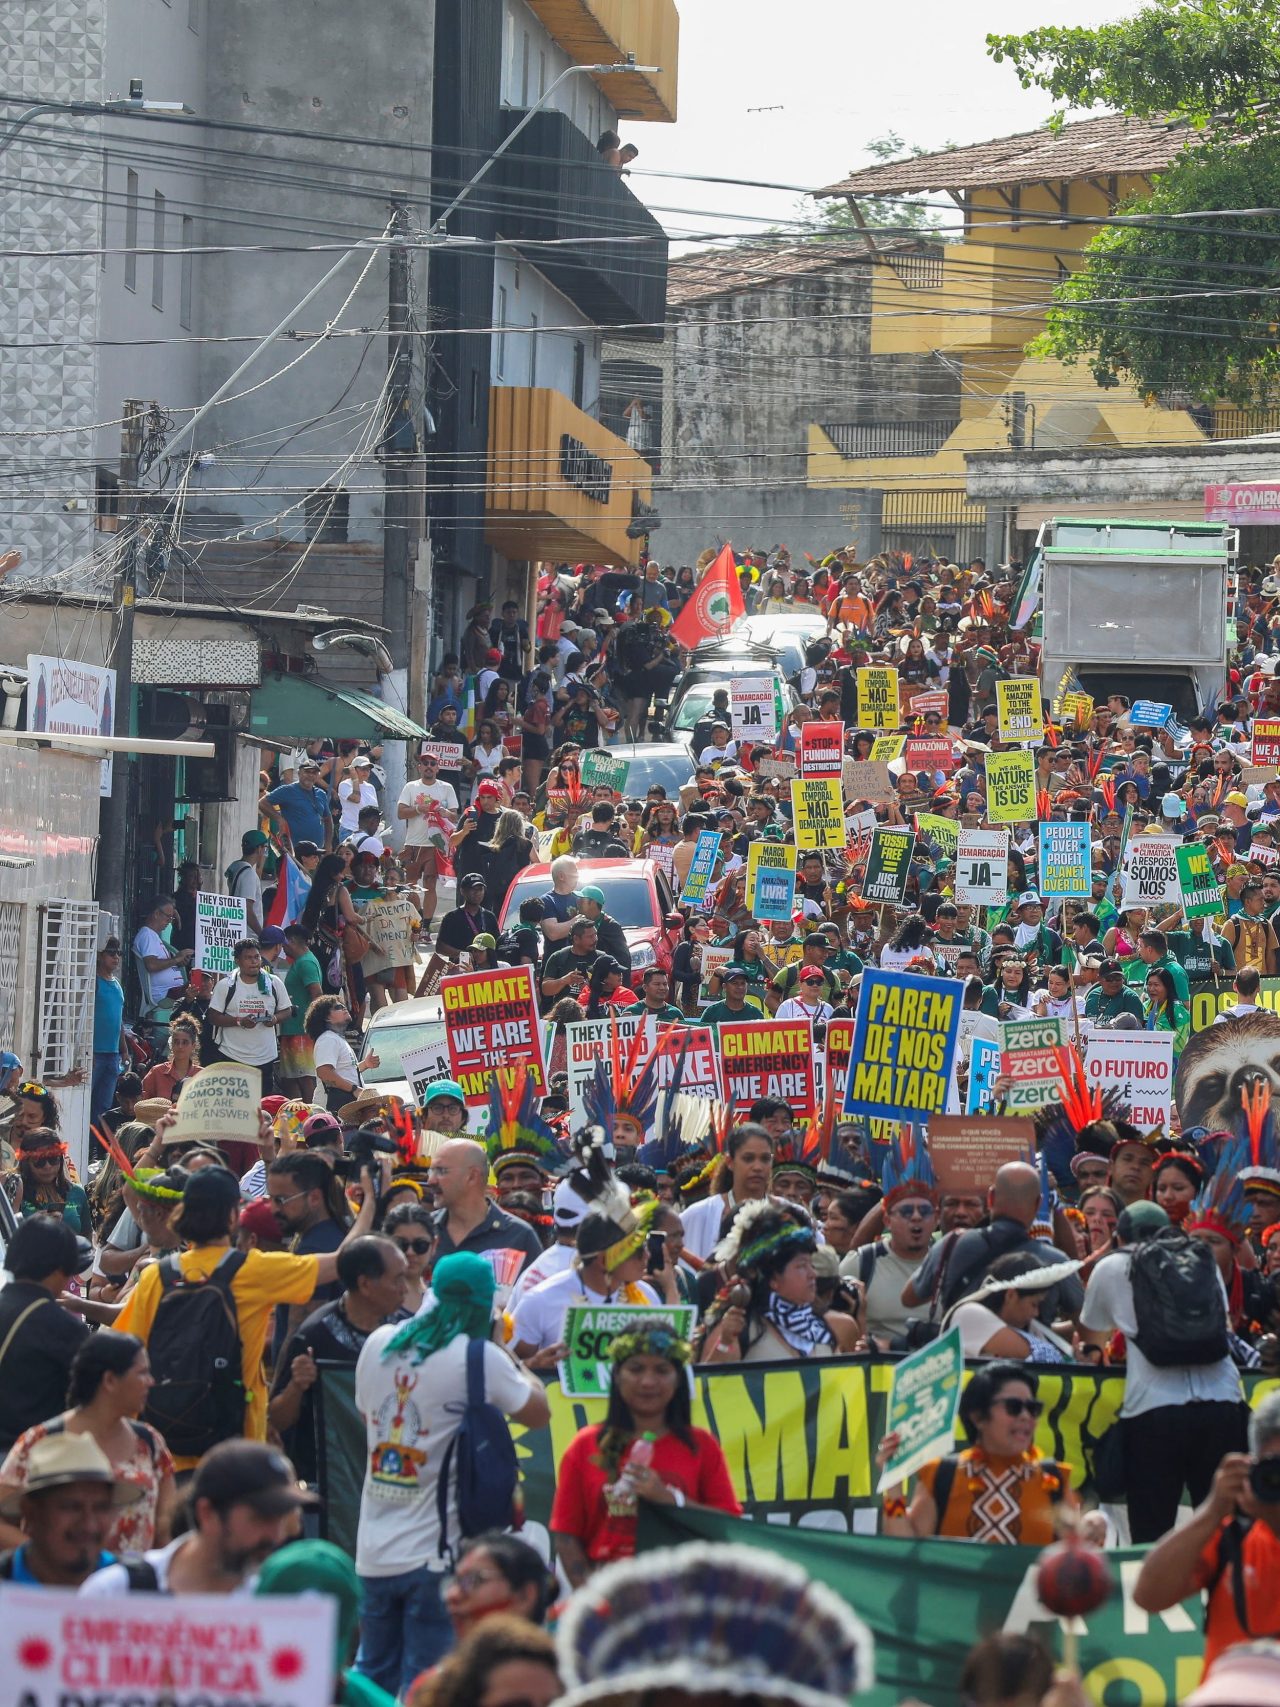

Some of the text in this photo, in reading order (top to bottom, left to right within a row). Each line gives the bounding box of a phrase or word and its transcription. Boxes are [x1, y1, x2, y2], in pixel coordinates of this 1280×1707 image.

[868, 670, 888, 679] MARCO
[864, 680, 892, 688] TEMPORAL
[1003, 684, 1033, 694] FROM THE
[732, 693, 772, 702] DEMARCAÇÃO
[1006, 692, 1032, 700] AMAZON
[1007, 708, 1033, 718] PACIFIC:
[1010, 716, 1032, 729] END
[1001, 729, 1021, 738] FOSSIL
[432, 745, 459, 753] FUTURO
[812, 738, 833, 749] STOP
[910, 741, 949, 751] AMAZÔNIA
[1256, 745, 1272, 755] WE
[804, 750, 840, 760] FUNDING
[988, 770, 1033, 786] NATURE
[805, 781, 828, 791] MARCO
[802, 790, 834, 800] TEMPORAL
[995, 790, 1028, 806] IS US
[807, 800, 830, 818] NÃO
[799, 819, 841, 829] DEMARCAÇÃO
[1046, 827, 1084, 839] PEOPLE
[879, 834, 908, 848] FOSSIL
[1051, 840, 1078, 852] OVER
[1140, 842, 1172, 850] EMERGÊNCIA
[763, 846, 784, 856] MARCO
[882, 848, 903, 861] FREE
[959, 847, 1006, 859] DEMARCAÇÃO
[1139, 848, 1171, 856] CLIMÁTICA
[758, 856, 788, 868] TEMPORAL
[1047, 853, 1083, 865] PROFIT
[1132, 857, 1138, 865] A
[1188, 854, 1209, 874] WE
[1047, 866, 1084, 878] PLANET
[1130, 866, 1177, 881] SOMOS
[876, 873, 898, 886] JUST
[1044, 879, 1088, 891] OVER OIL
[1193, 874, 1211, 890] ARE
[761, 885, 788, 899] LIVRE
[867, 886, 900, 899] FUTURE
[1184, 888, 1220, 907] NATURE
[200, 895, 241, 908] THEY STOLE
[198, 904, 244, 920] OUR LANDS
[211, 918, 228, 928] NOW
[200, 925, 242, 940] THEY WANT
[204, 936, 212, 945] TO
[211, 946, 230, 959] OUR
[444, 976, 530, 1010] CLIMATE
[447, 1000, 532, 1030] EMERGENCY
[868, 984, 954, 1033] PAREM
[570, 1024, 603, 1043] THEY
[1006, 1022, 1057, 1033] DESMATAMENTO
[451, 1020, 532, 1053] WE ARE
[722, 1029, 809, 1057] CLIMATE
[1007, 1028, 1058, 1053] zero
[572, 1039, 604, 1062] OUR
[863, 1023, 897, 1065] DE
[897, 1028, 946, 1072] NOS
[436, 1056, 447, 1071] A
[481, 1050, 508, 1068] THE
[724, 1054, 809, 1075] EMERGENCY
[658, 1049, 713, 1087] AKE
[1010, 1056, 1061, 1076] zero
[1090, 1060, 1168, 1080] O FUTURO
[194, 1077, 248, 1089] RESPOSTA
[728, 1075, 762, 1104] WE
[767, 1072, 807, 1100] ARE
[1124, 1081, 1132, 1098] É
[184, 1088, 223, 1101] SOMOS
[852, 1063, 946, 1118] MATAR!
[1012, 1084, 1061, 1104] zero
[193, 1098, 234, 1108] WE ARE
[182, 1109, 249, 1120] THE ANSWER
[580, 1309, 594, 1330] A
[61, 1612, 262, 1652] EMERGÊNCIA
[61, 1644, 262, 1694] CLIMÁTICA
